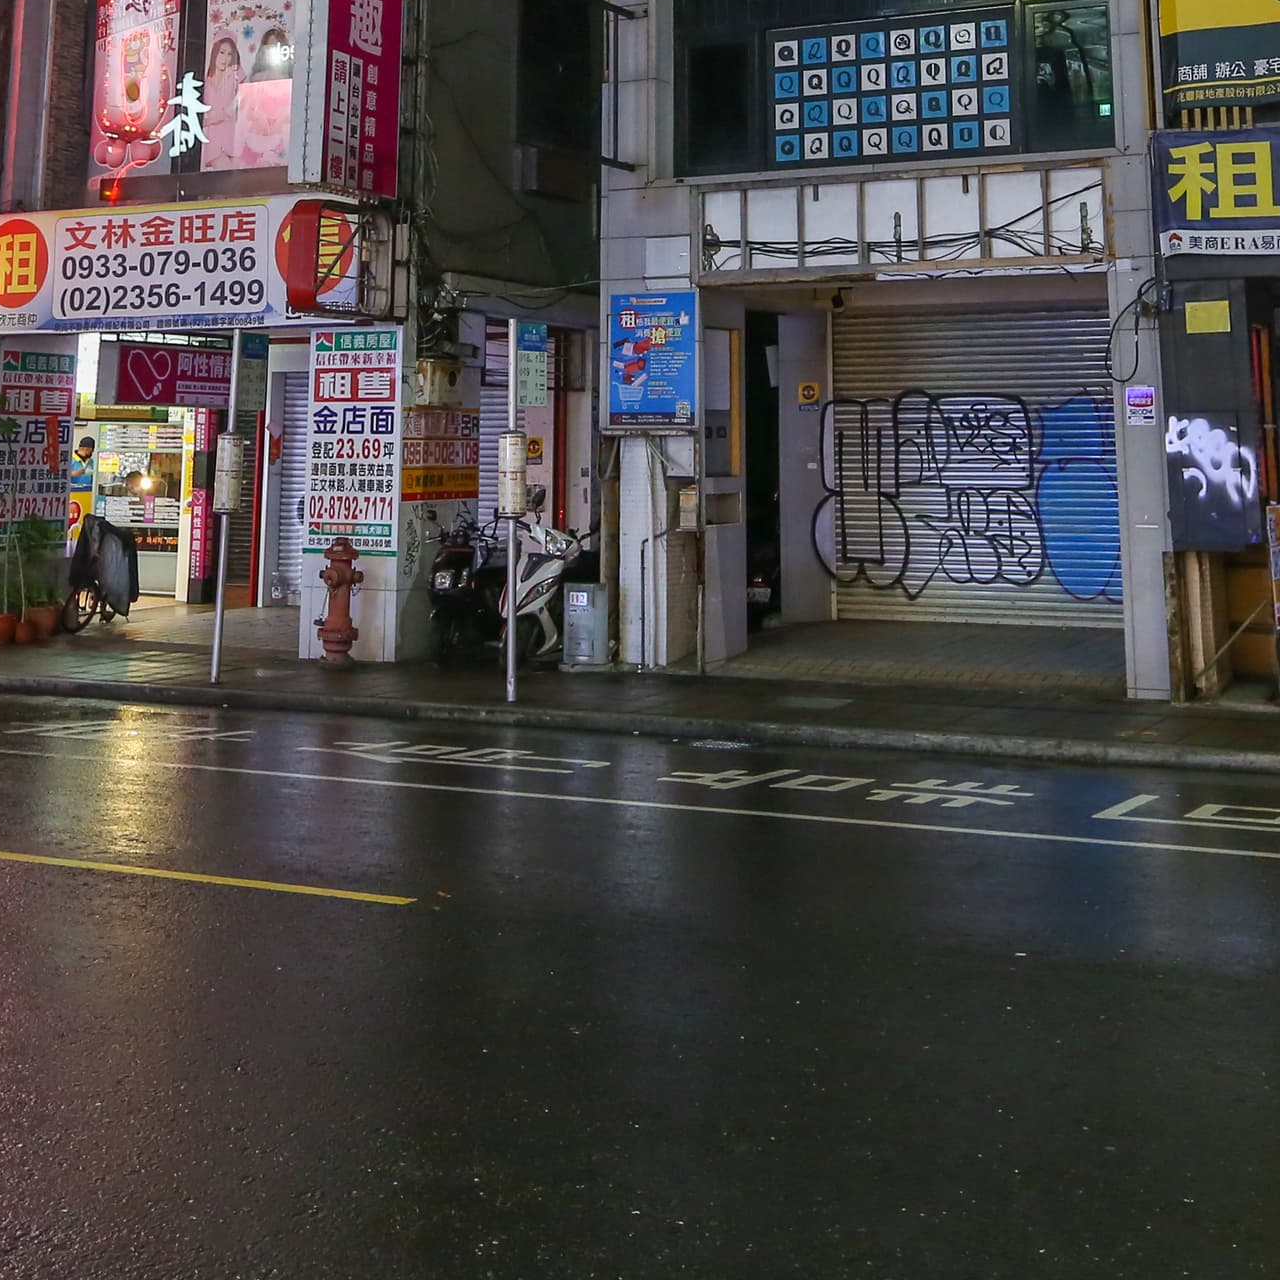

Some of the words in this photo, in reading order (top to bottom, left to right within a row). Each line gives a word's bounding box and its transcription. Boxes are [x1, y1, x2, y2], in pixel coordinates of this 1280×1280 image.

[1215, 61, 1245, 77] 辦公
[330, 58, 348, 182] 請上二樓
[1168, 140, 1280, 220] 租
[65, 211, 257, 251] 文林金旺店
[62, 246, 257, 280] 0933-079-036
[60, 278, 266, 317] (02)2356-1499
[341, 334, 391, 350] 信義房屋
[316, 352, 396, 367] 信任帶來新幸福
[320, 371, 391, 399] 租售
[4, 389, 69, 413] 租售
[313, 405, 395, 435] 金店面
[309, 496, 393, 521] 02-8792-7171
